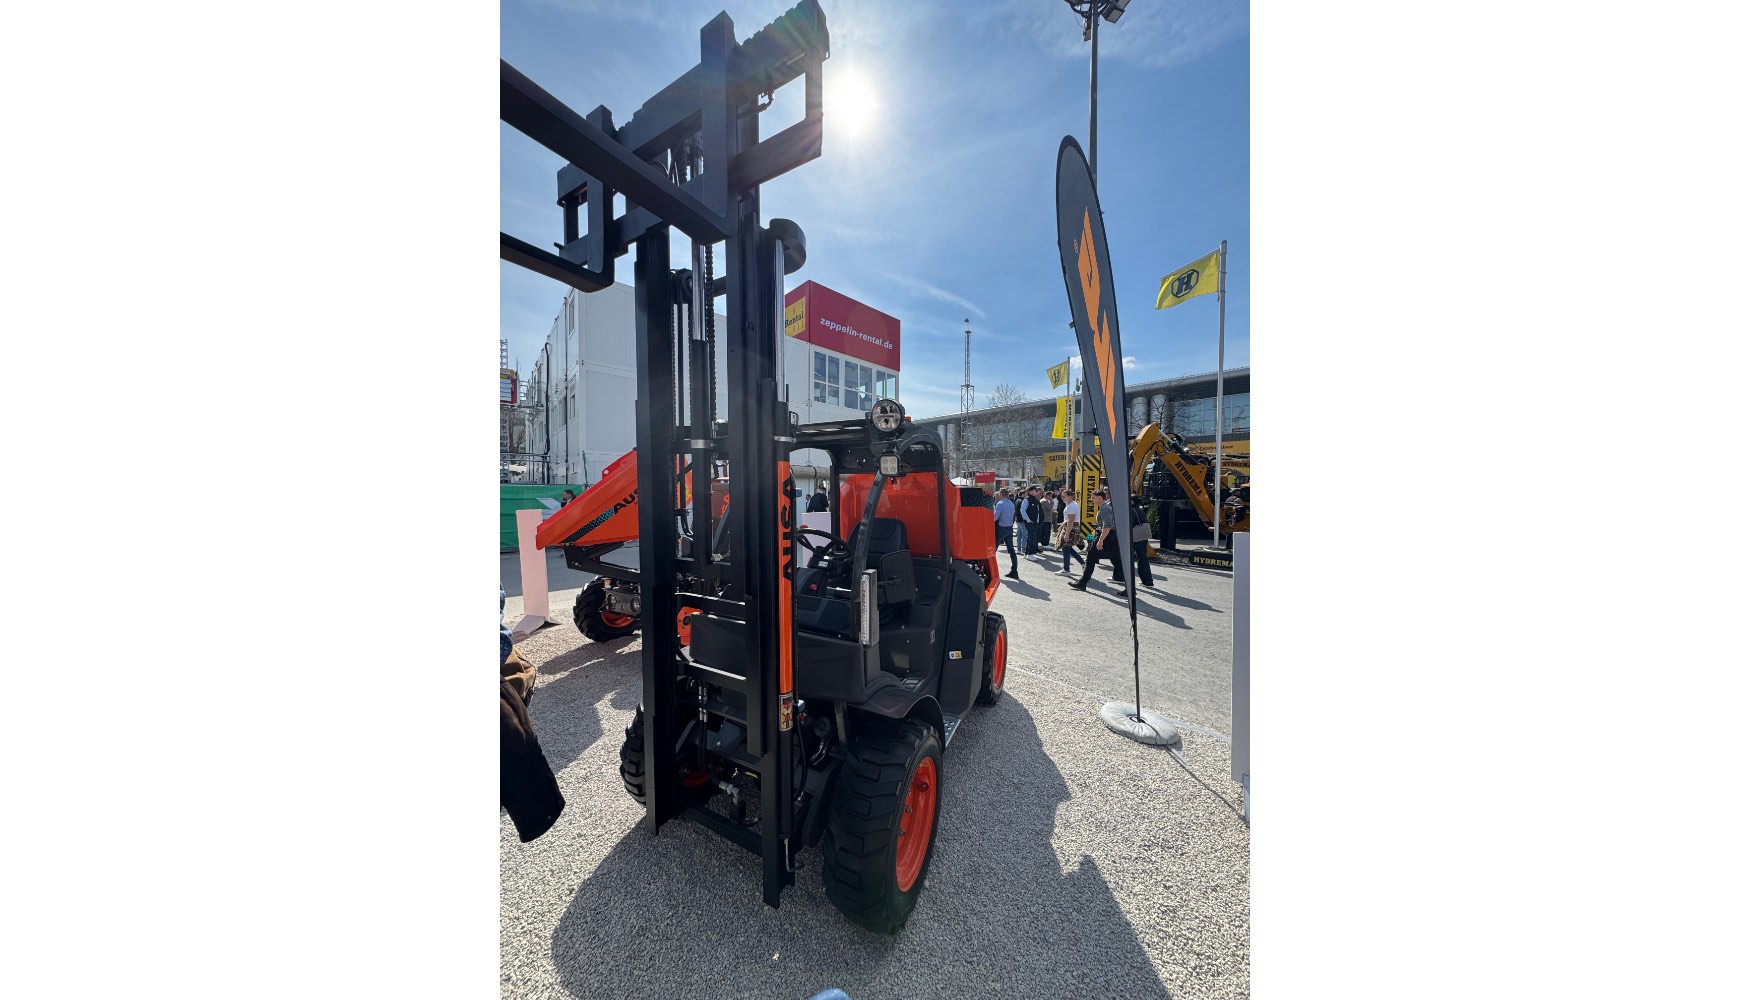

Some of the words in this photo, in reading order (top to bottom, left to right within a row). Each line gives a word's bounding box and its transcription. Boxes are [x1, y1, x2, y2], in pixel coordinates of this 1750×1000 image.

[785, 310, 804, 328] Rental
[820, 318, 892, 350] zeppelin-rental.de
[1175, 461, 1202, 496] HYDREMA
